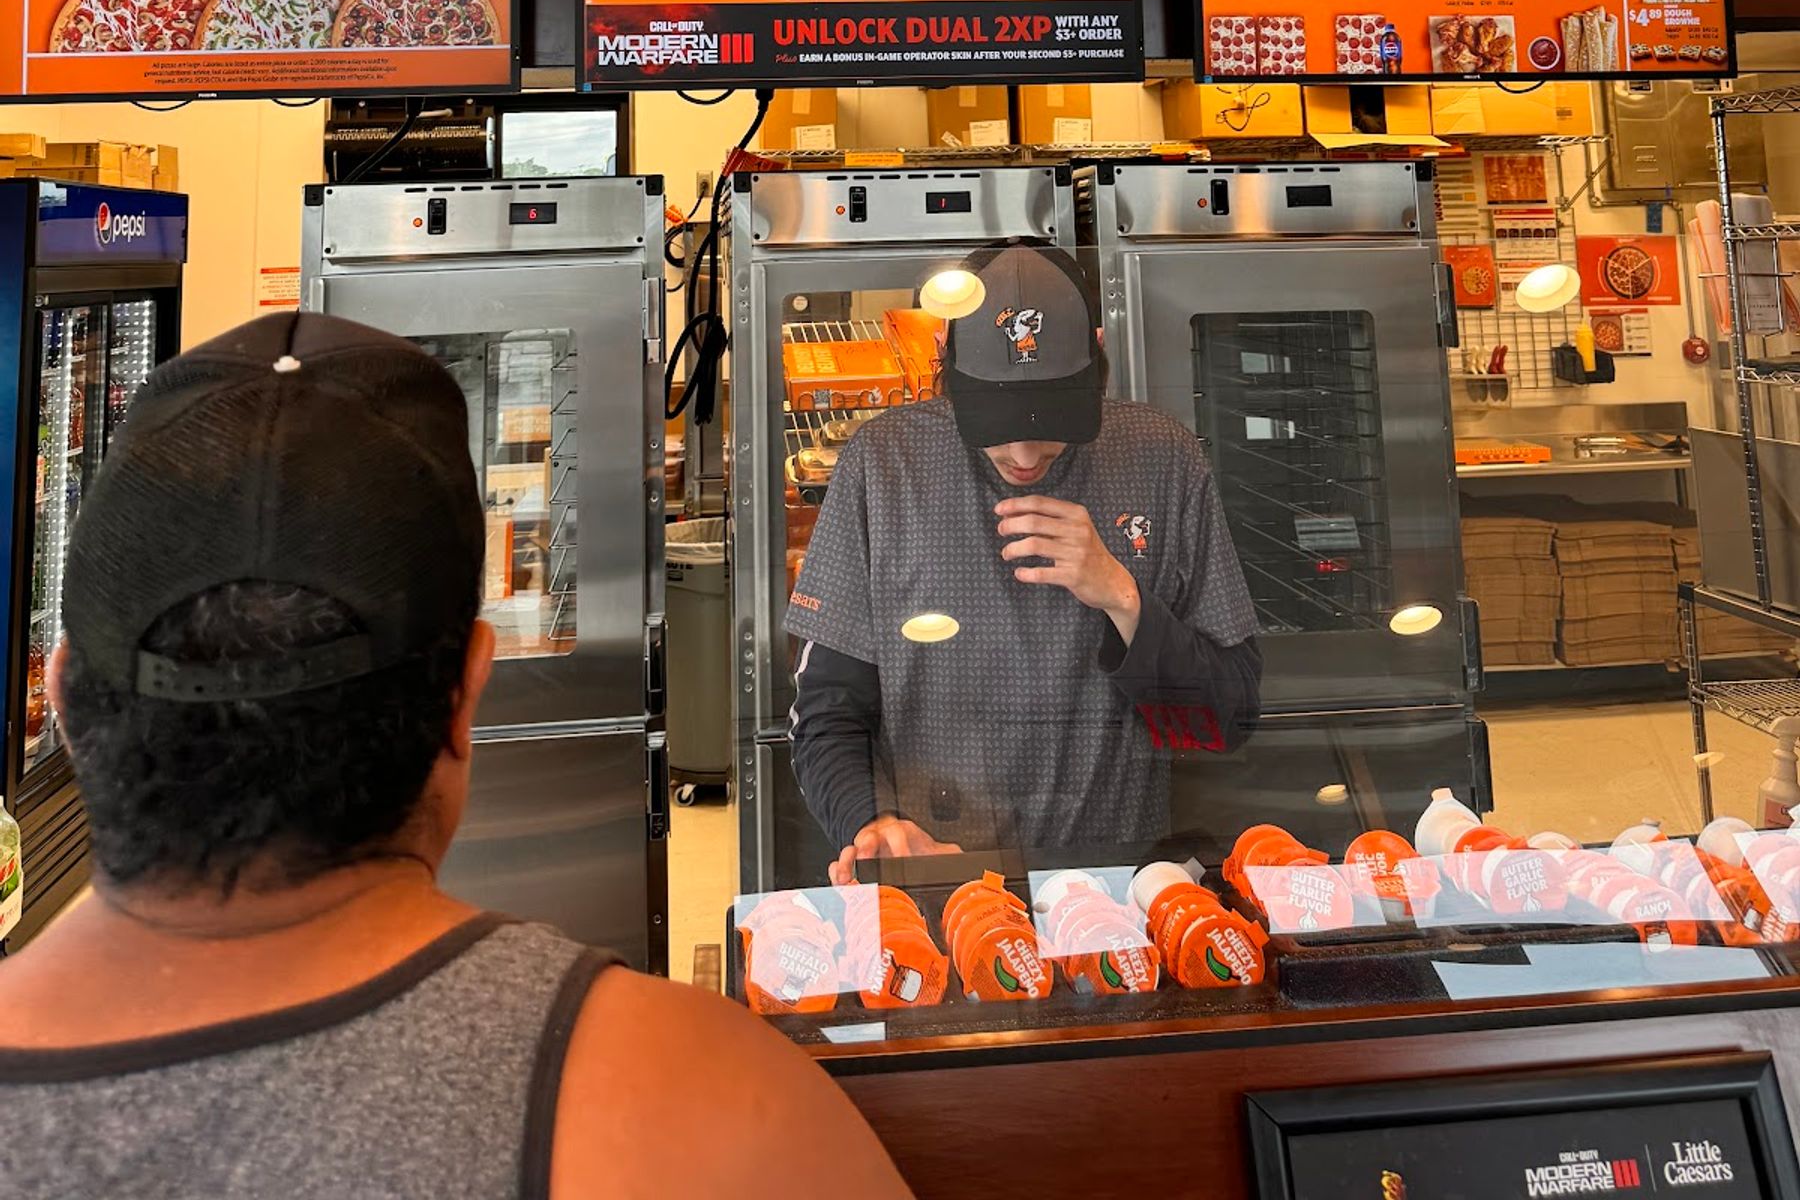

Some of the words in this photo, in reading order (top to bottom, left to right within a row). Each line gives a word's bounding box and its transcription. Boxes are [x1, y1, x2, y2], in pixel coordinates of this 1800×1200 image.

[650, 21, 673, 32] CALL
[678, 21, 704, 32] DUTY
[773, 17, 899, 45] UNLOCK
[906, 16, 988, 43] DUAL
[994, 15, 1052, 42] 2XP
[1055, 15, 1089, 28] WITH
[1091, 14, 1119, 27] ANY
[598, 34, 718, 50] MODERN
[1055, 29, 1076, 41] $3+
[1079, 28, 1122, 40] ORDER
[598, 49, 719, 65] WARFARE
[720, 33, 754, 64] III
[799, 53, 824, 64] EARN
[824, 54, 831, 63] A
[832, 53, 863, 63] BONUS
[864, 52, 902, 62] IN-GAME
[903, 51, 950, 61] OPERATOR
[951, 51, 972, 61] SKIN
[973, 50, 1000, 60] AFTER
[1001, 50, 1027, 60] YOUR
[1027, 49, 1062, 59] SECOND
[1078, 48, 1124, 58] PURCHASE
[112, 210, 146, 242] pepsi
[1502, 858, 1543, 878] BUTTER
[1505, 868, 1546, 888] GARLIC
[1291, 870, 1335, 893] BUTTER
[1507, 878, 1547, 900] FLAVOR
[1291, 883, 1332, 904] GARLIC
[1288, 895, 1332, 916] FLAVOR
[1635, 901, 1672, 918] RANCH
[779, 942, 829, 974] BUFFALO
[1123, 936, 1149, 983] CHEEZY
[1224, 927, 1258, 970] CHEEZY
[779, 956, 820, 985] RANCH
[1013, 938, 1048, 983] CHEEZY
[1672, 1140, 1722, 1165] Little
[1525, 1160, 1612, 1183] MODERN
[1527, 1175, 1615, 1197] WARFARE
[1612, 1159, 1640, 1188] III
[1664, 1160, 1733, 1186] Caesars
